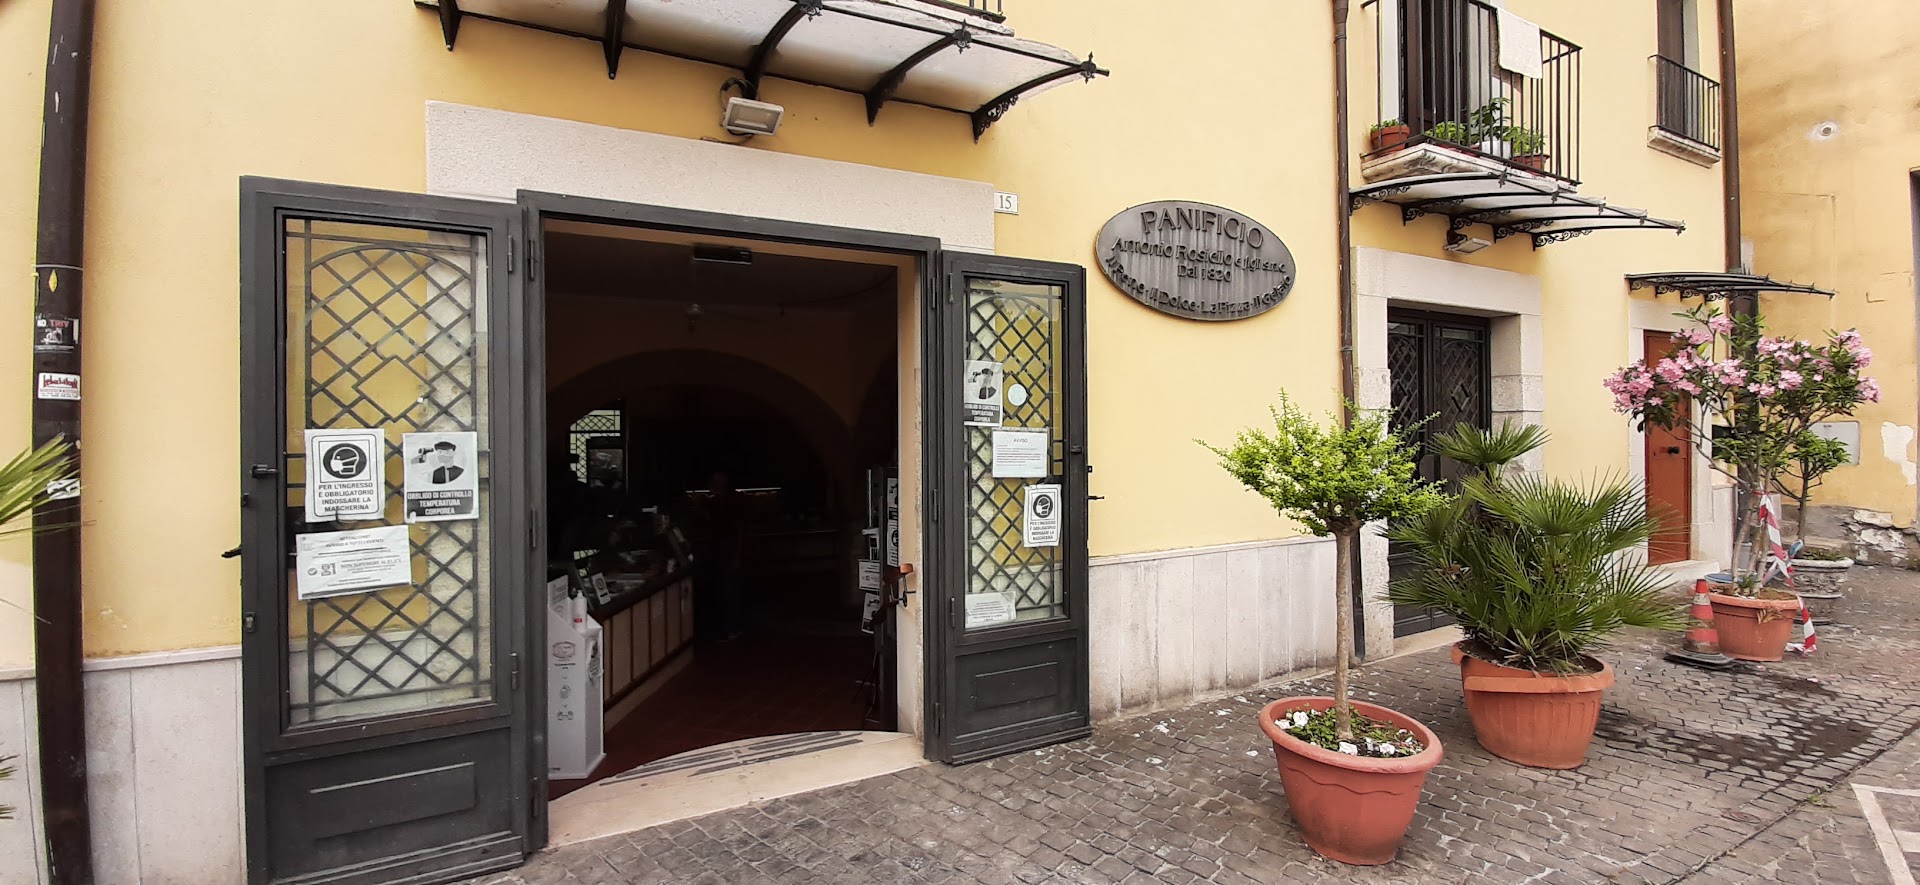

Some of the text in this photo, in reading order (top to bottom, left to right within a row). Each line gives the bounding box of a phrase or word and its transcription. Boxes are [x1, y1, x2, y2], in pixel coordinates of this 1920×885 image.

[999, 194, 1012, 210] 15
[1140, 207, 1264, 249] PANIFICIO
[1111, 237, 1174, 258] Antonio
[1175, 244, 1233, 266] Rosiello
[1234, 256, 1242, 267] e
[1177, 264, 1232, 283] Dal 1820
[1105, 255, 1119, 268] Il
[1149, 286, 1159, 302] Il
[1158, 290, 1198, 312] Dolce
[1201, 301, 1216, 314] La
[1218, 301, 1250, 314] Pizza
[1253, 295, 1261, 309] Il
[1261, 275, 1291, 305] Gelato
[334, 482, 373, 490] L'INGRESSO
[324, 489, 374, 498] OBBLIGATORIO
[407, 492, 432, 500] OBBLIGO
[440, 490, 472, 499] CONTROLLO
[321, 497, 361, 505] INDOSSARE
[419, 499, 461, 507] TEMPERATURA
[324, 504, 369, 512] MASCHERINA
[424, 507, 455, 515] CORPOREA
